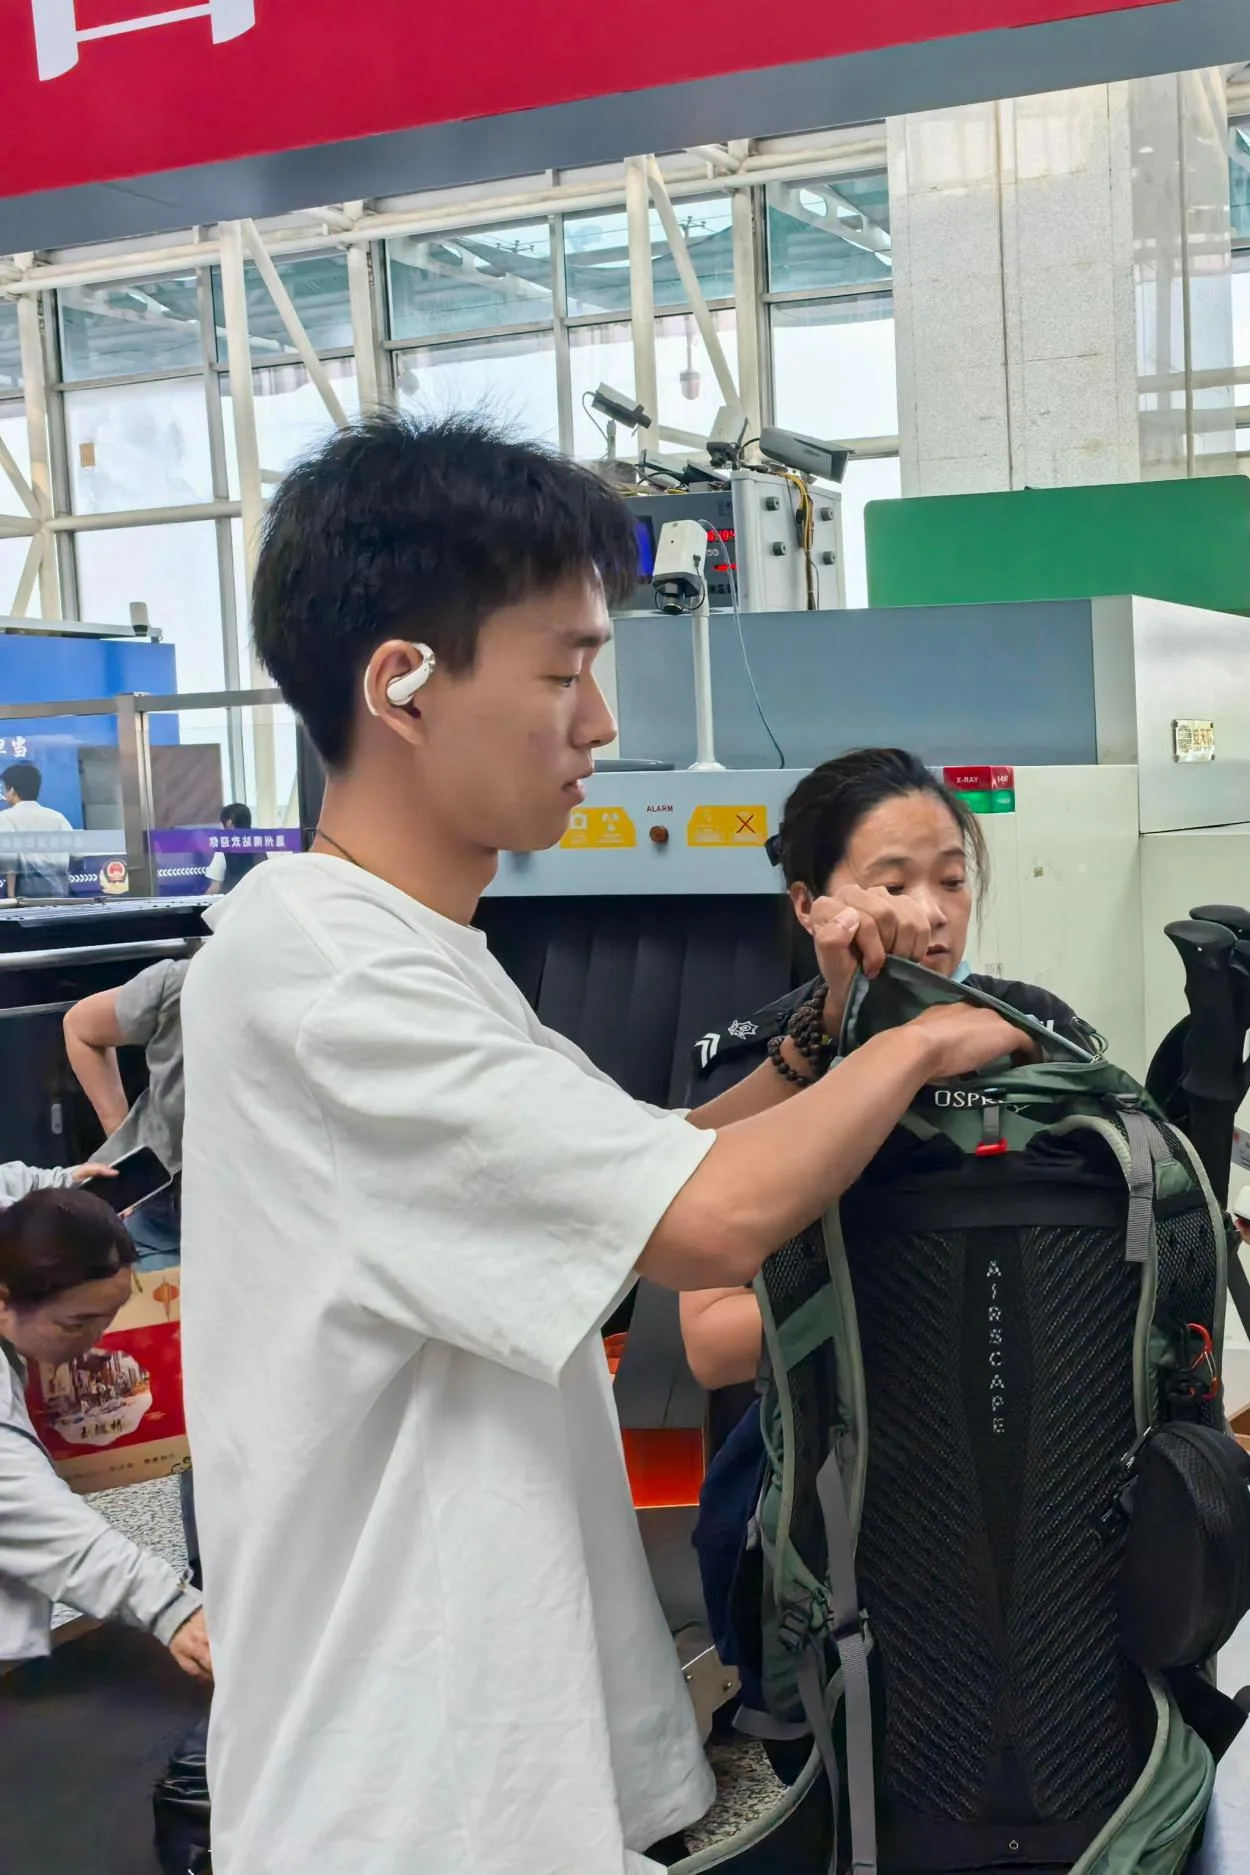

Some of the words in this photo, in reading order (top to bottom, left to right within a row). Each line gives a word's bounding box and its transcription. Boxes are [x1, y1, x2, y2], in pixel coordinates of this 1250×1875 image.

[956, 776, 979, 784] X-RAY
[646, 805, 673, 813] ALARM
[986, 1260, 1005, 1433] AIRSCAPE
